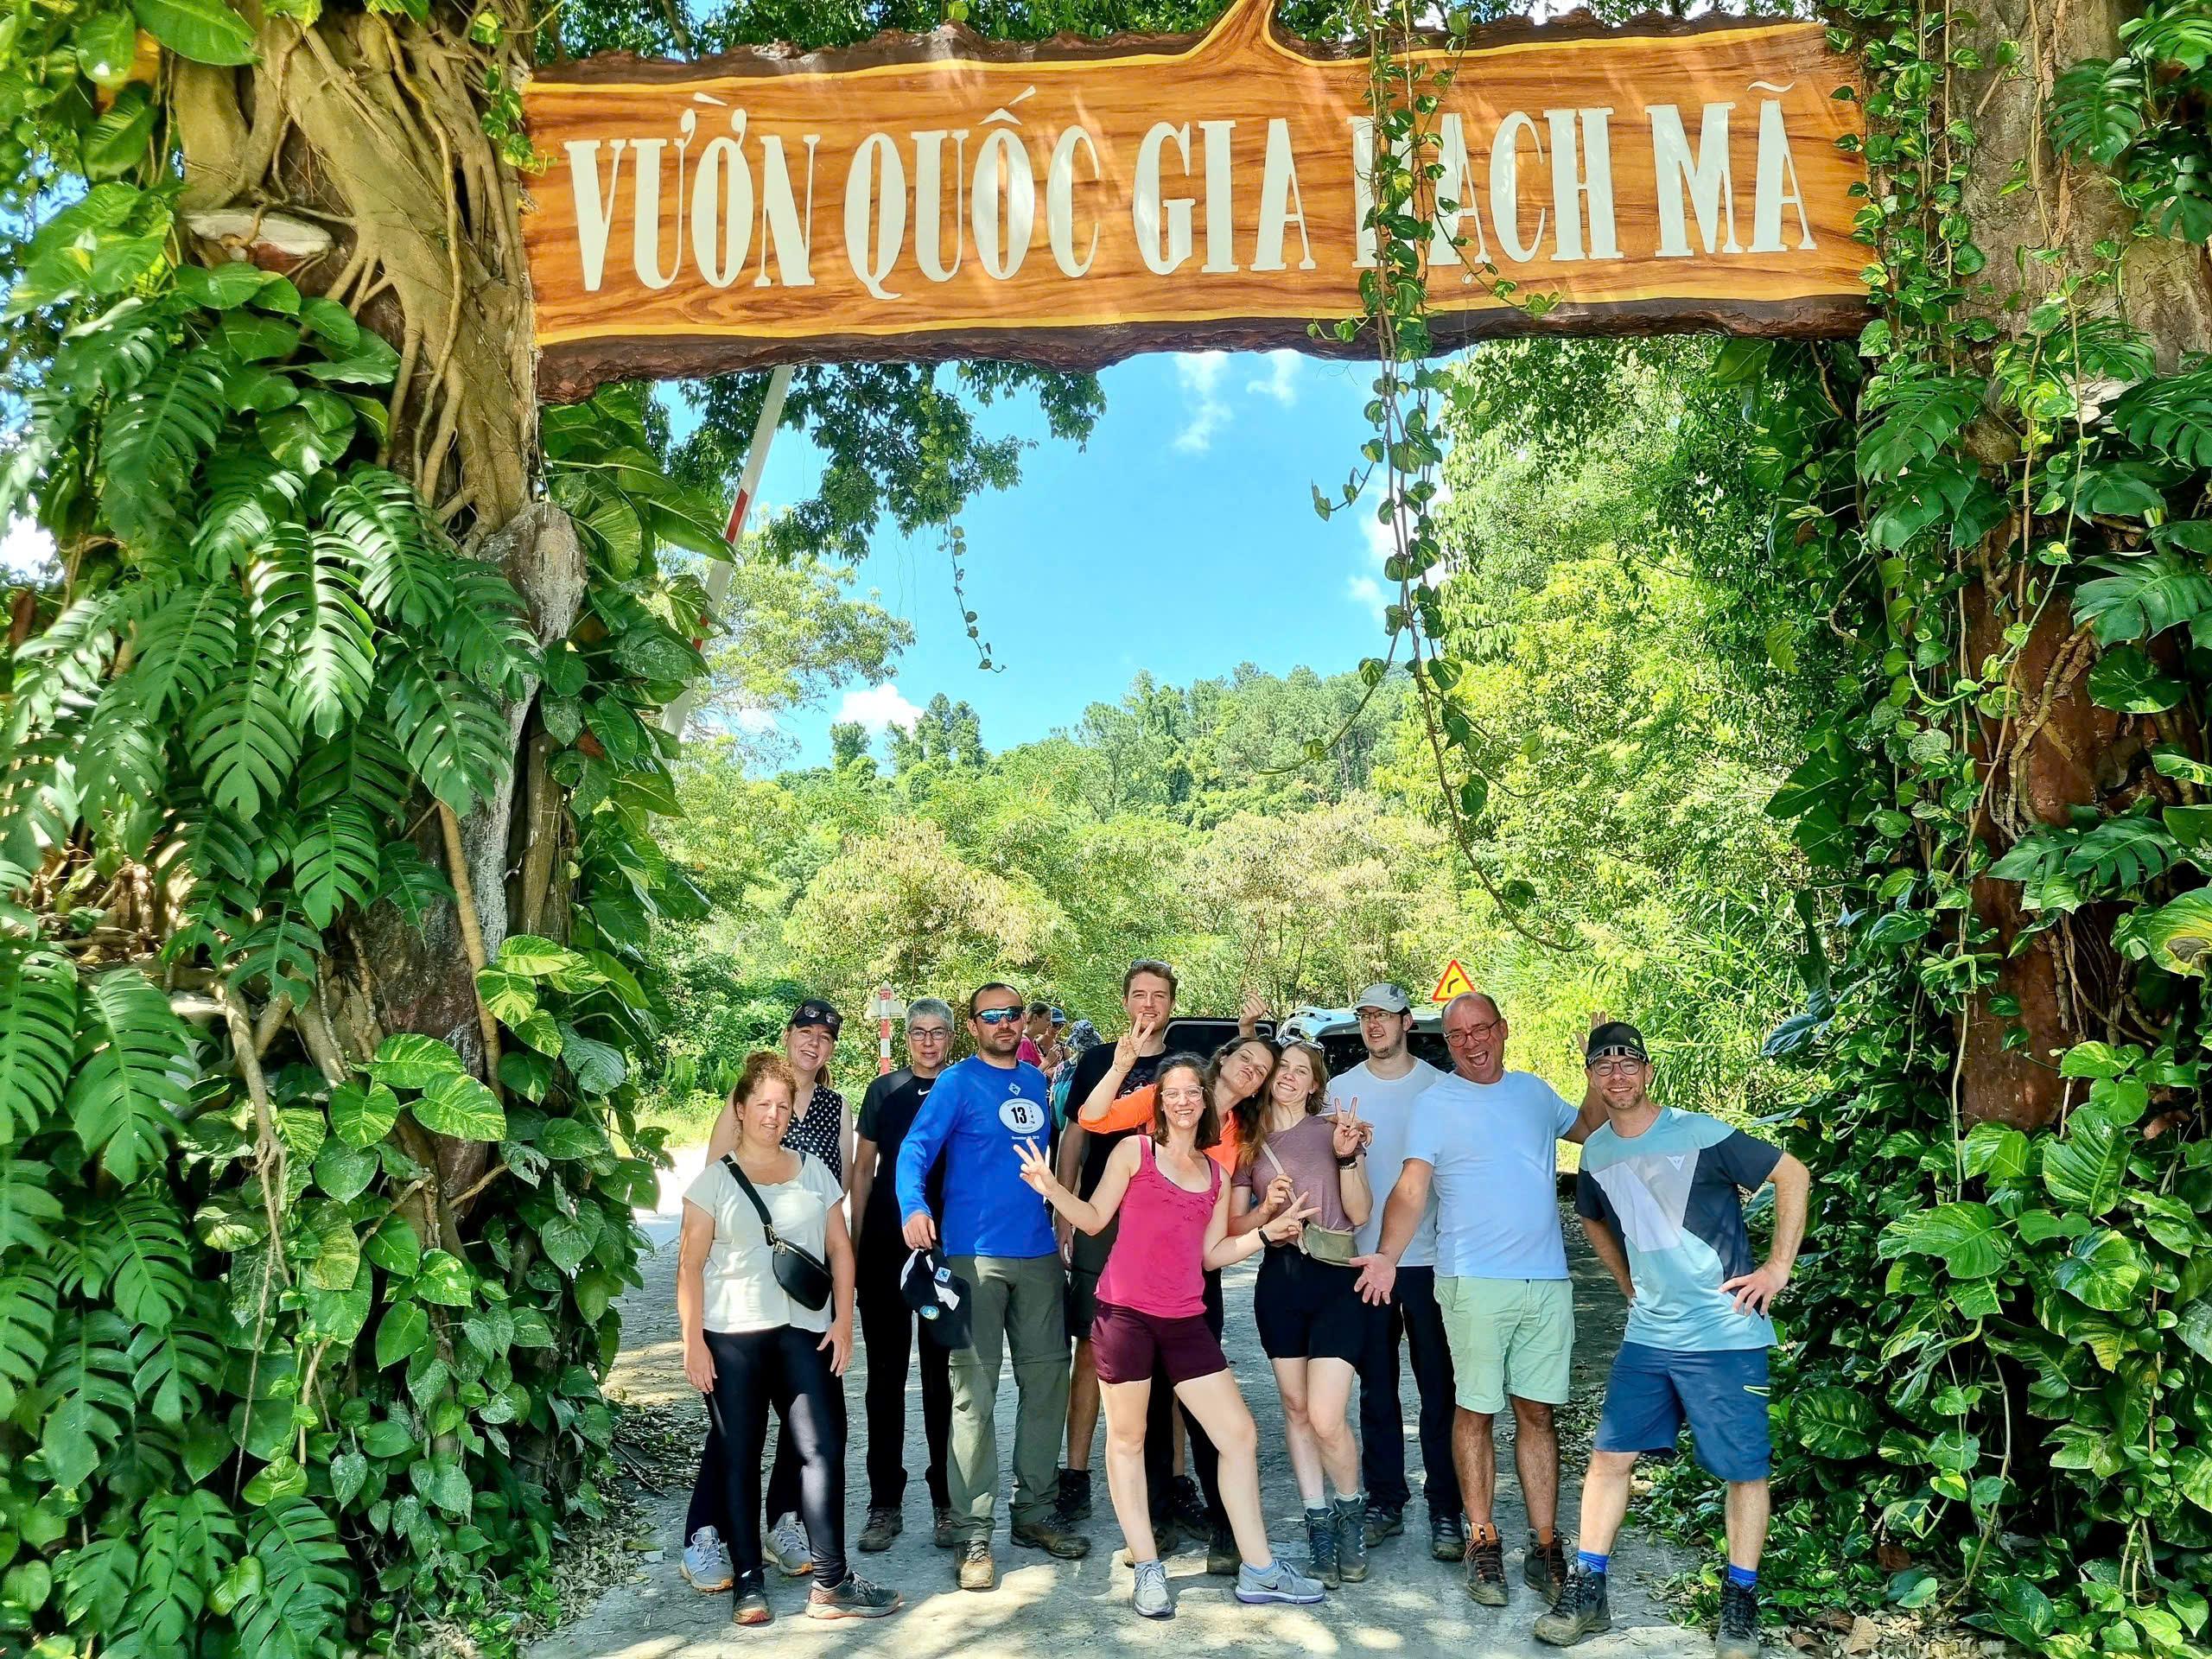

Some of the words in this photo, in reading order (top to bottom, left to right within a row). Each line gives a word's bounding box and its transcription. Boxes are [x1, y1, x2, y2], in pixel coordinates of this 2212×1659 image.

[563, 91, 821, 292] VƯỜN
[842, 86, 1100, 300] QUỐC
[1131, 118, 1317, 276] GIA
[1644, 79, 1817, 257] MÃ
[1011, 1107, 1027, 1124] 13
